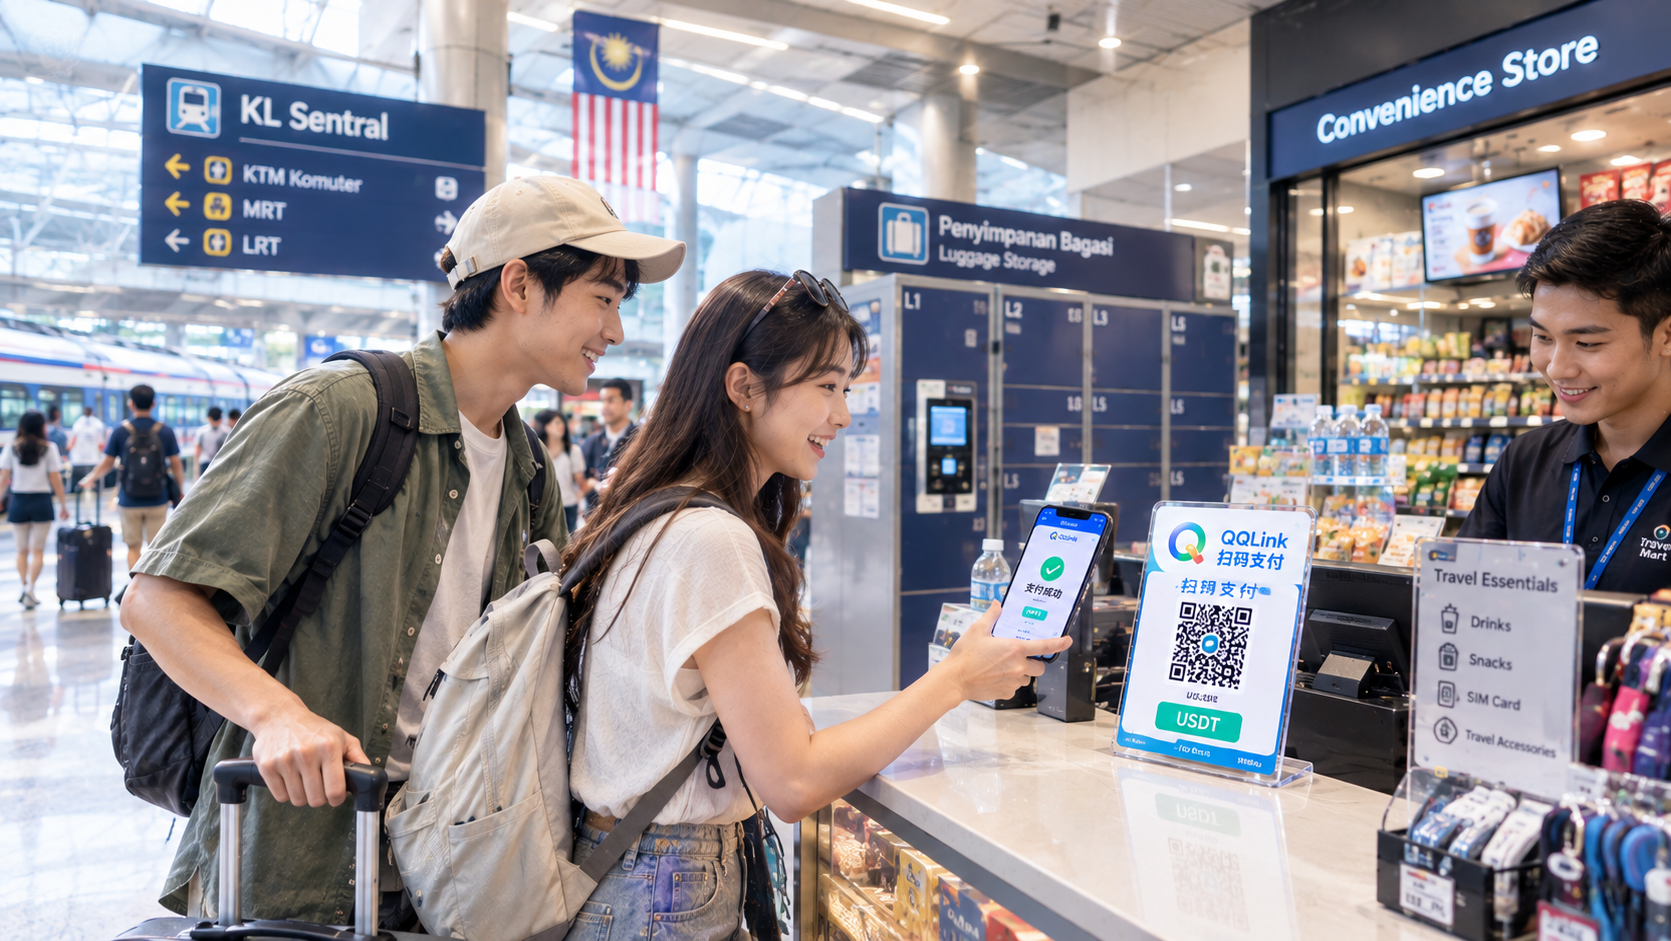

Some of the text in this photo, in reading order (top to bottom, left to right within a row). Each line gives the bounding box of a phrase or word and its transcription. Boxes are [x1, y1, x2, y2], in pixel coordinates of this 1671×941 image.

[1317, 34, 1599, 144] Convenience Store
[240, 94, 389, 141] KL Sentral
[243, 164, 363, 194] KTM Komuter
[243, 200, 287, 221] MRT
[243, 235, 281, 256] LRT
[939, 215, 1114, 259] Penyimpanan Bagasi
[939, 244, 1056, 276] Luggage Storage
[904, 291, 921, 310] L1
[1005, 301, 1023, 319] L2
[1220, 529, 1288, 549] QQLink
[1217, 549, 1284, 571] 扫码支付
[1639, 547, 1668, 561] Mart
[1434, 568, 1558, 593] Travel Essentials
[1471, 615, 1512, 632] Drinks
[1469, 653, 1513, 671] Snacks
[1467, 691, 1521, 711] SIM Card
[1176, 711, 1221, 732] USDT
[1465, 729, 1557, 759] Travel Accessories
